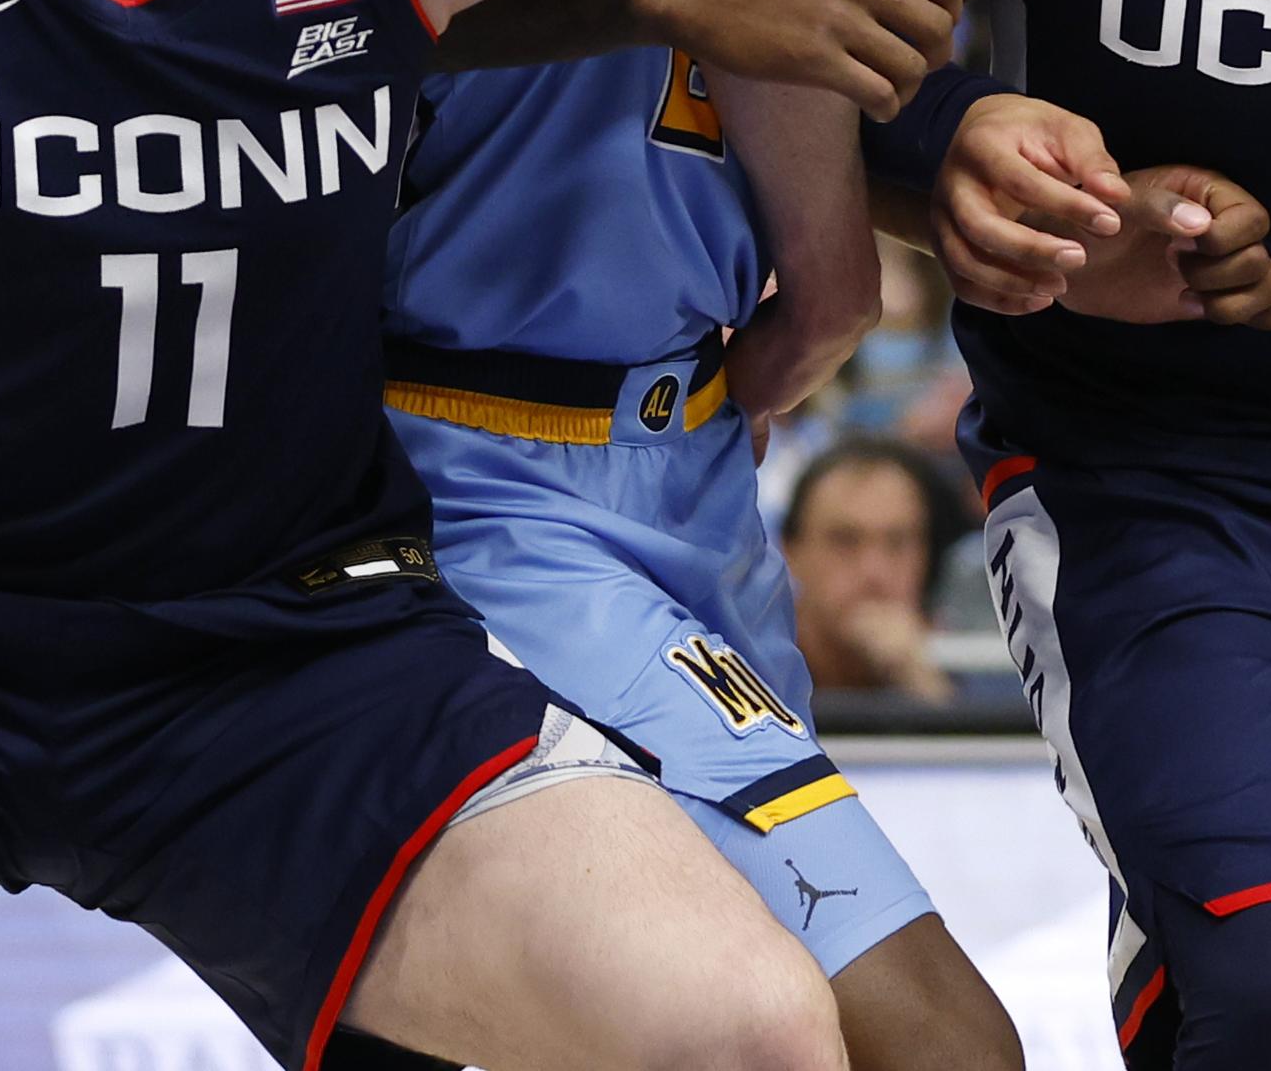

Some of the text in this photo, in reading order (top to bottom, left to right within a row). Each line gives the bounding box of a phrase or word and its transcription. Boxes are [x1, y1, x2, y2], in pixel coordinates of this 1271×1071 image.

[291, 29, 374, 67] EAST
[296, 16, 358, 47] BIG
[100, 247, 238, 430] 11
[643, 385, 671, 418] AL
[668, 635, 803, 734] MU
